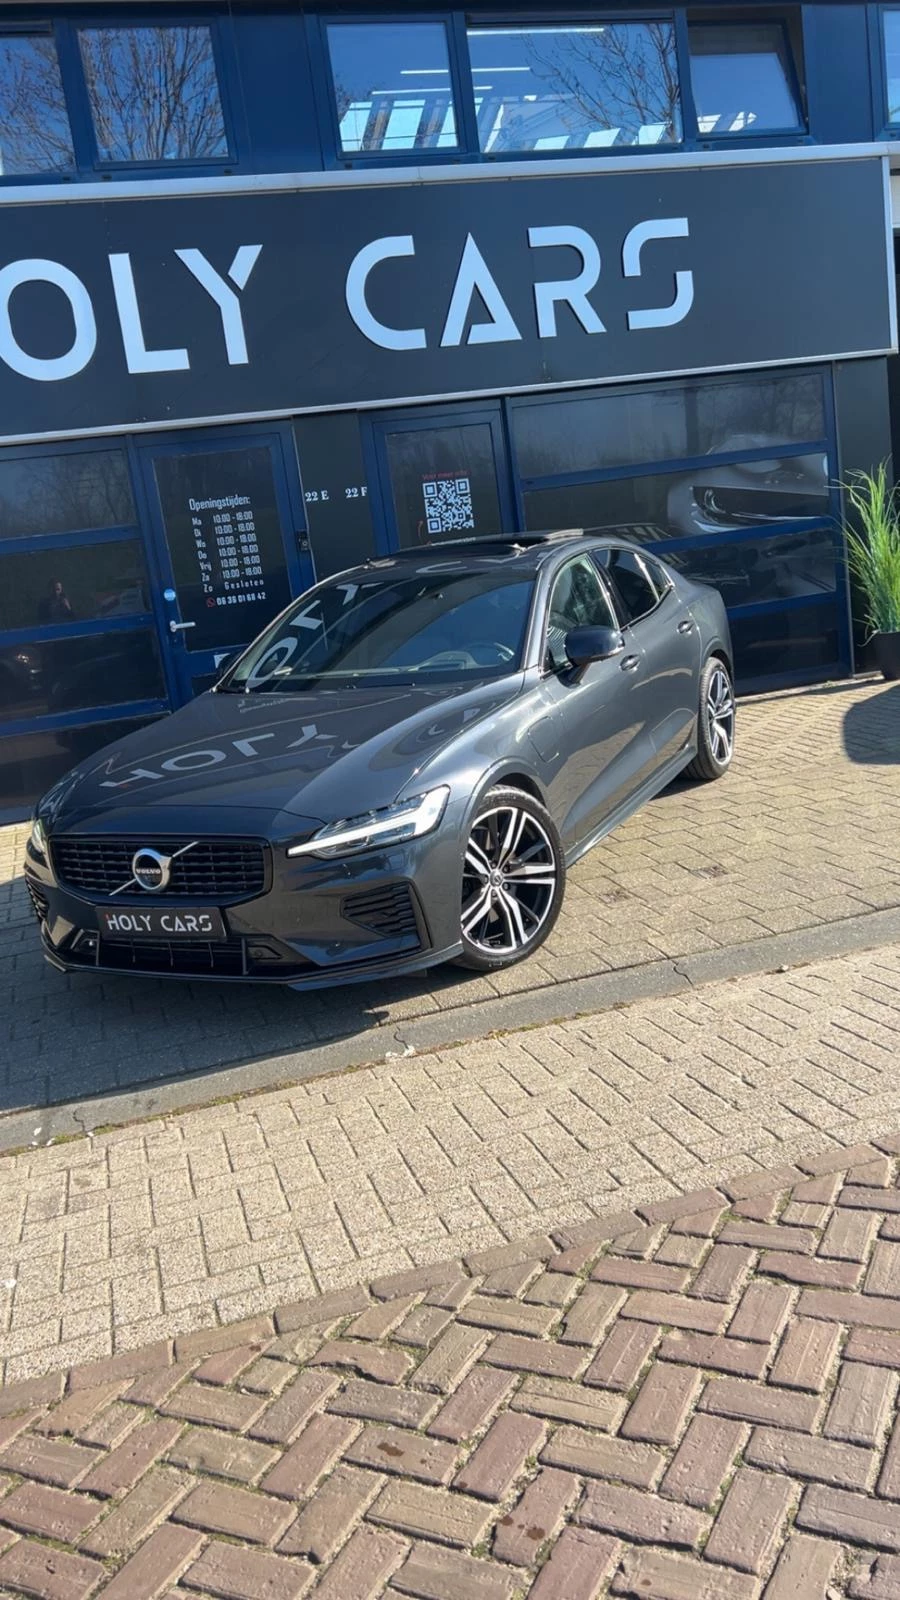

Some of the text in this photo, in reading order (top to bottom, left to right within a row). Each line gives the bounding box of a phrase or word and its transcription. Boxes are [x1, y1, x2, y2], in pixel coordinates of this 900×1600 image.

[0, 217, 694, 381] OLY CARS
[305, 490, 329, 502] 22 E
[345, 486, 368, 498] 22 F
[188, 494, 251, 512] Openingstijden:
[224, 580, 264, 590] Gesloten
[106, 914, 212, 932] HOLY CARS
